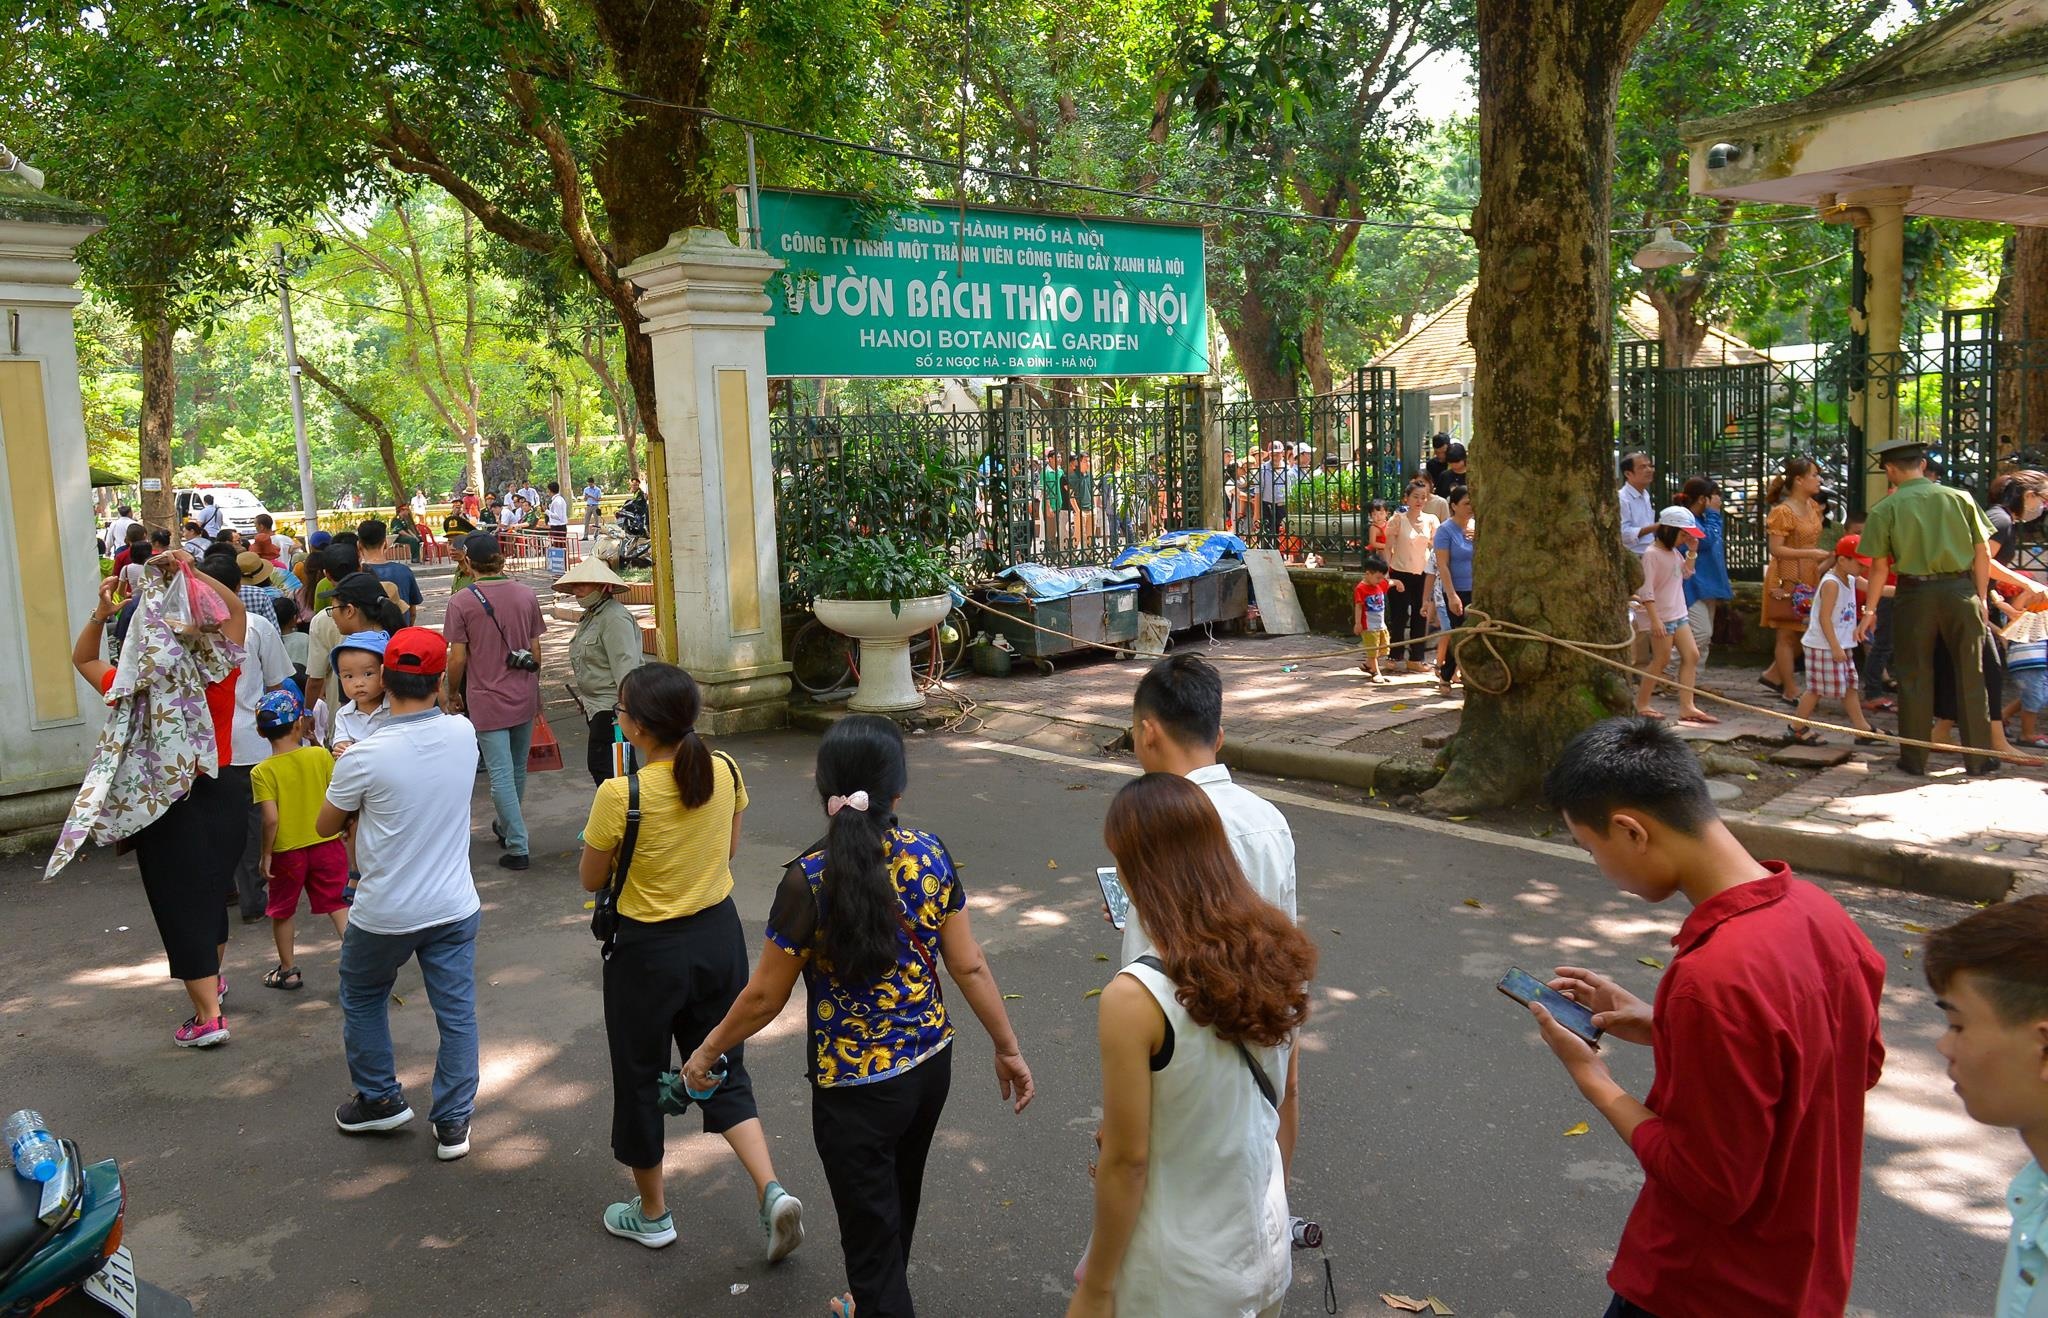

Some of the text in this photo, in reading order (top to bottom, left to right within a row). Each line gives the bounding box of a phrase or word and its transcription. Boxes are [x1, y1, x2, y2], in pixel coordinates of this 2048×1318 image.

[893, 217, 1104, 250] UBND THÀNH PHỐ HÀ NỘI
[781, 231, 1185, 277] CÔNG TY TNHH MỘT THÀNH VIÊN CÔNG VIÊN CÂY XANH HÀ NỘI
[782, 265, 1187, 336] VƯỜN BÁCH THẢO HÀ NỘI
[860, 328, 1139, 351] HANOI BOTANICAL GARDEN
[915, 352, 934, 368] SỐ
[936, 357, 943, 367] 2
[946, 356, 980, 370] NGỌC
[983, 354, 1000, 367] HÀ
[1009, 357, 1025, 368] BA
[1027, 354, 1053, 368] ĐÌNH
[1062, 354, 1077, 368] HÀ
[1079, 355, 1097, 370] NỘI
